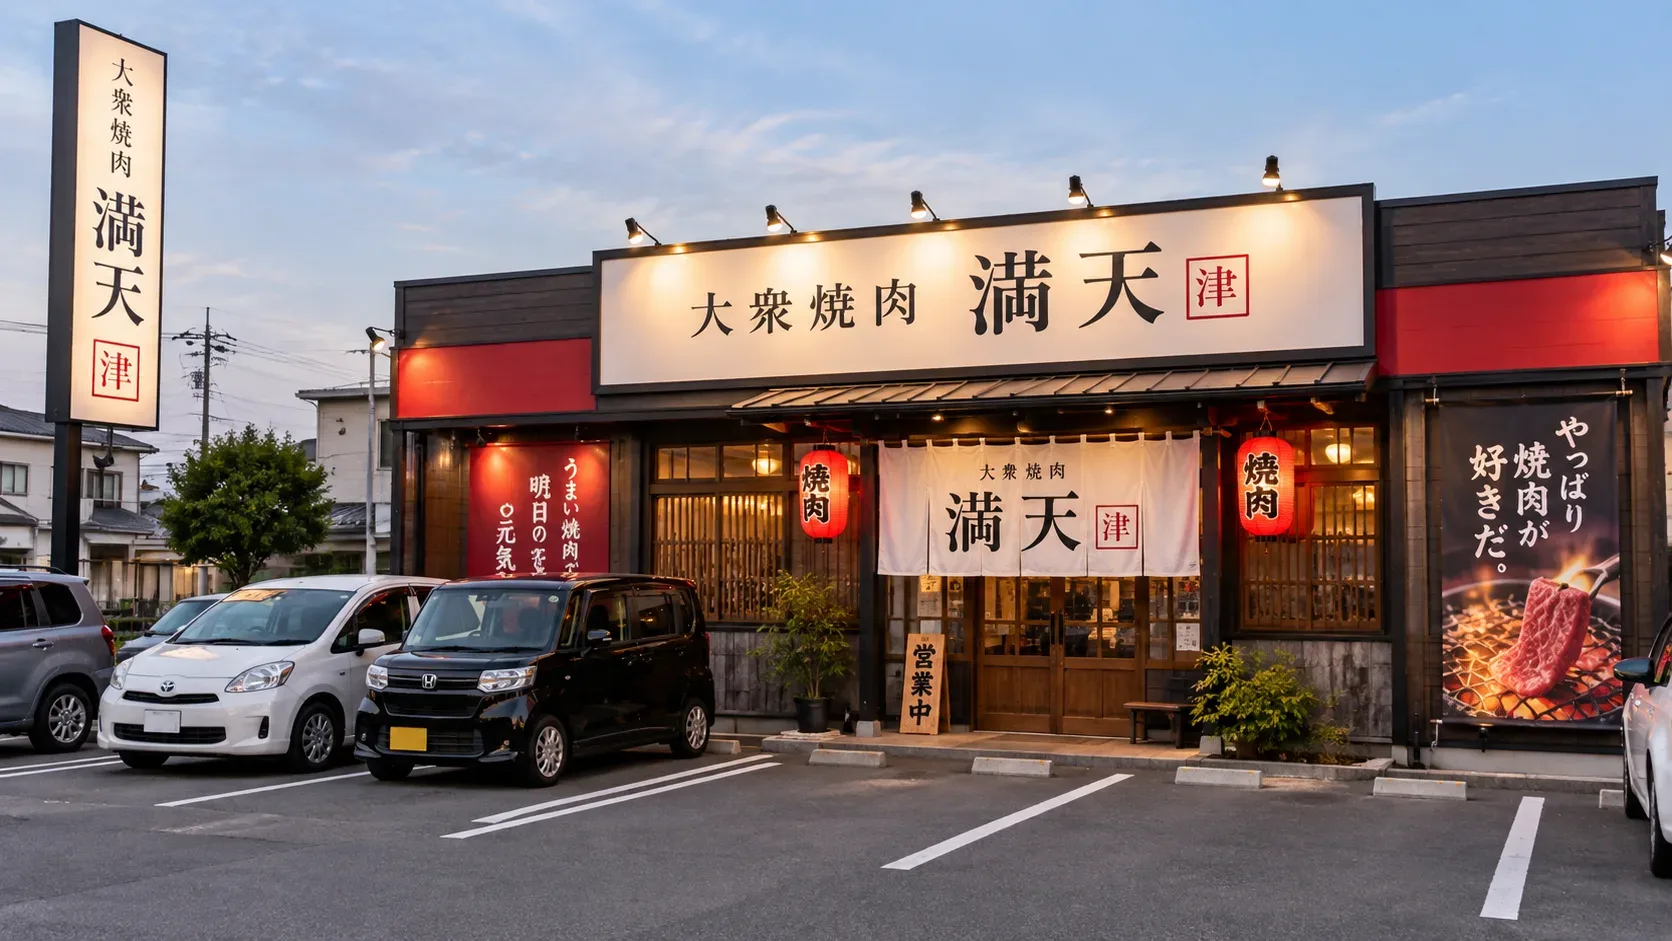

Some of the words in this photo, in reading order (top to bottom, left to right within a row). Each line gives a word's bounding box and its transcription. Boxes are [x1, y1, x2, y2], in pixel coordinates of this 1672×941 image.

[111, 58, 133, 178] 大衆焼肉
[92, 187, 145, 326] 満天
[691, 278, 916, 338] 大衆焼肉
[969, 241, 1164, 336] 満天
[1196, 265, 1238, 307] 津
[101, 350, 132, 390] 津
[802, 463, 830, 524] 焼肉
[979, 461, 1066, 481] 大衆焼肉
[1243, 452, 1279, 519] 焼肉
[1469, 444, 1509, 574] 好きだ。
[1513, 441, 1552, 548] 焼肉が
[945, 490, 1081, 552] 満天
[1102, 511, 1130, 542] 津
[909, 643, 936, 726] 営業中
